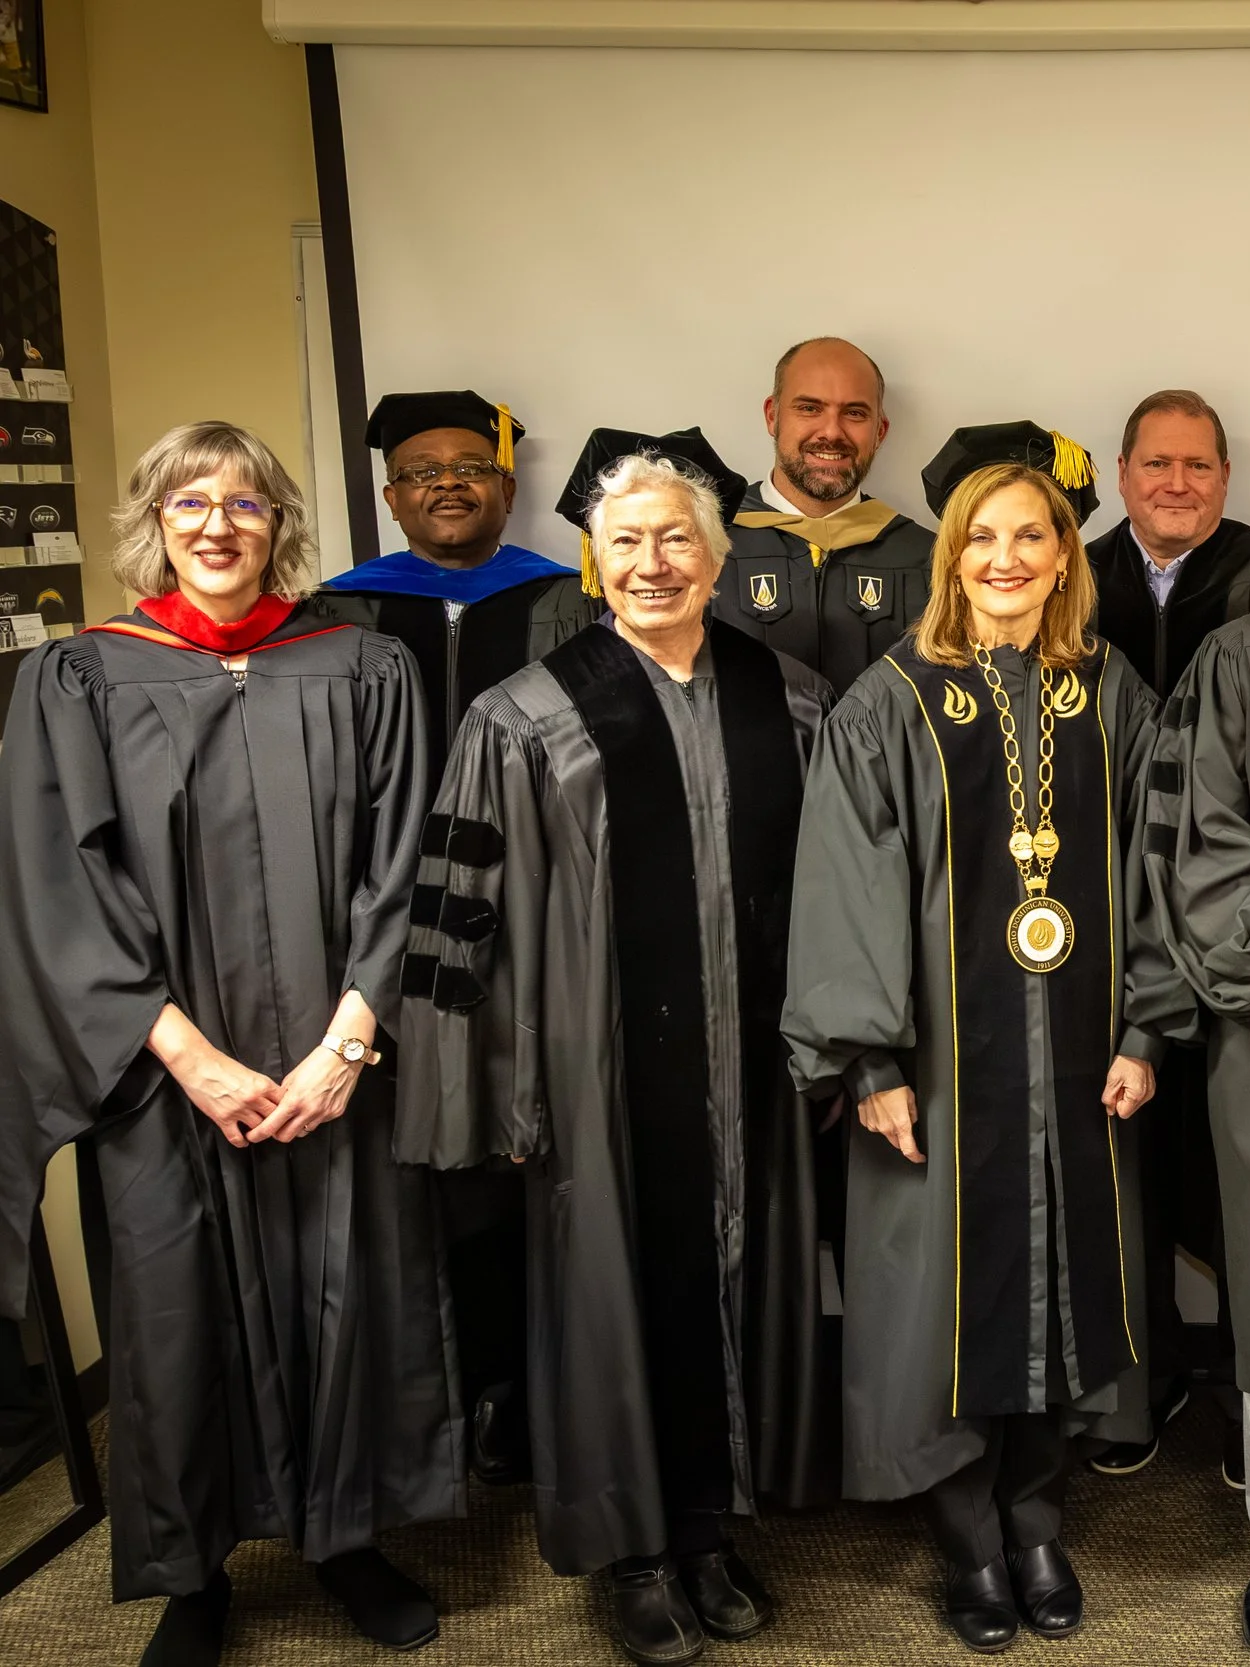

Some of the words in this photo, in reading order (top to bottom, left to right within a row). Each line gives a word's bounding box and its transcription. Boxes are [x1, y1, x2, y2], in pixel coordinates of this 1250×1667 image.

[1012, 901, 1048, 929] DOMINICAN
[1050, 903, 1072, 945] UNIVERSITY
[1011, 930, 1020, 953] OHIO
[1037, 961, 1051, 969] 1911
